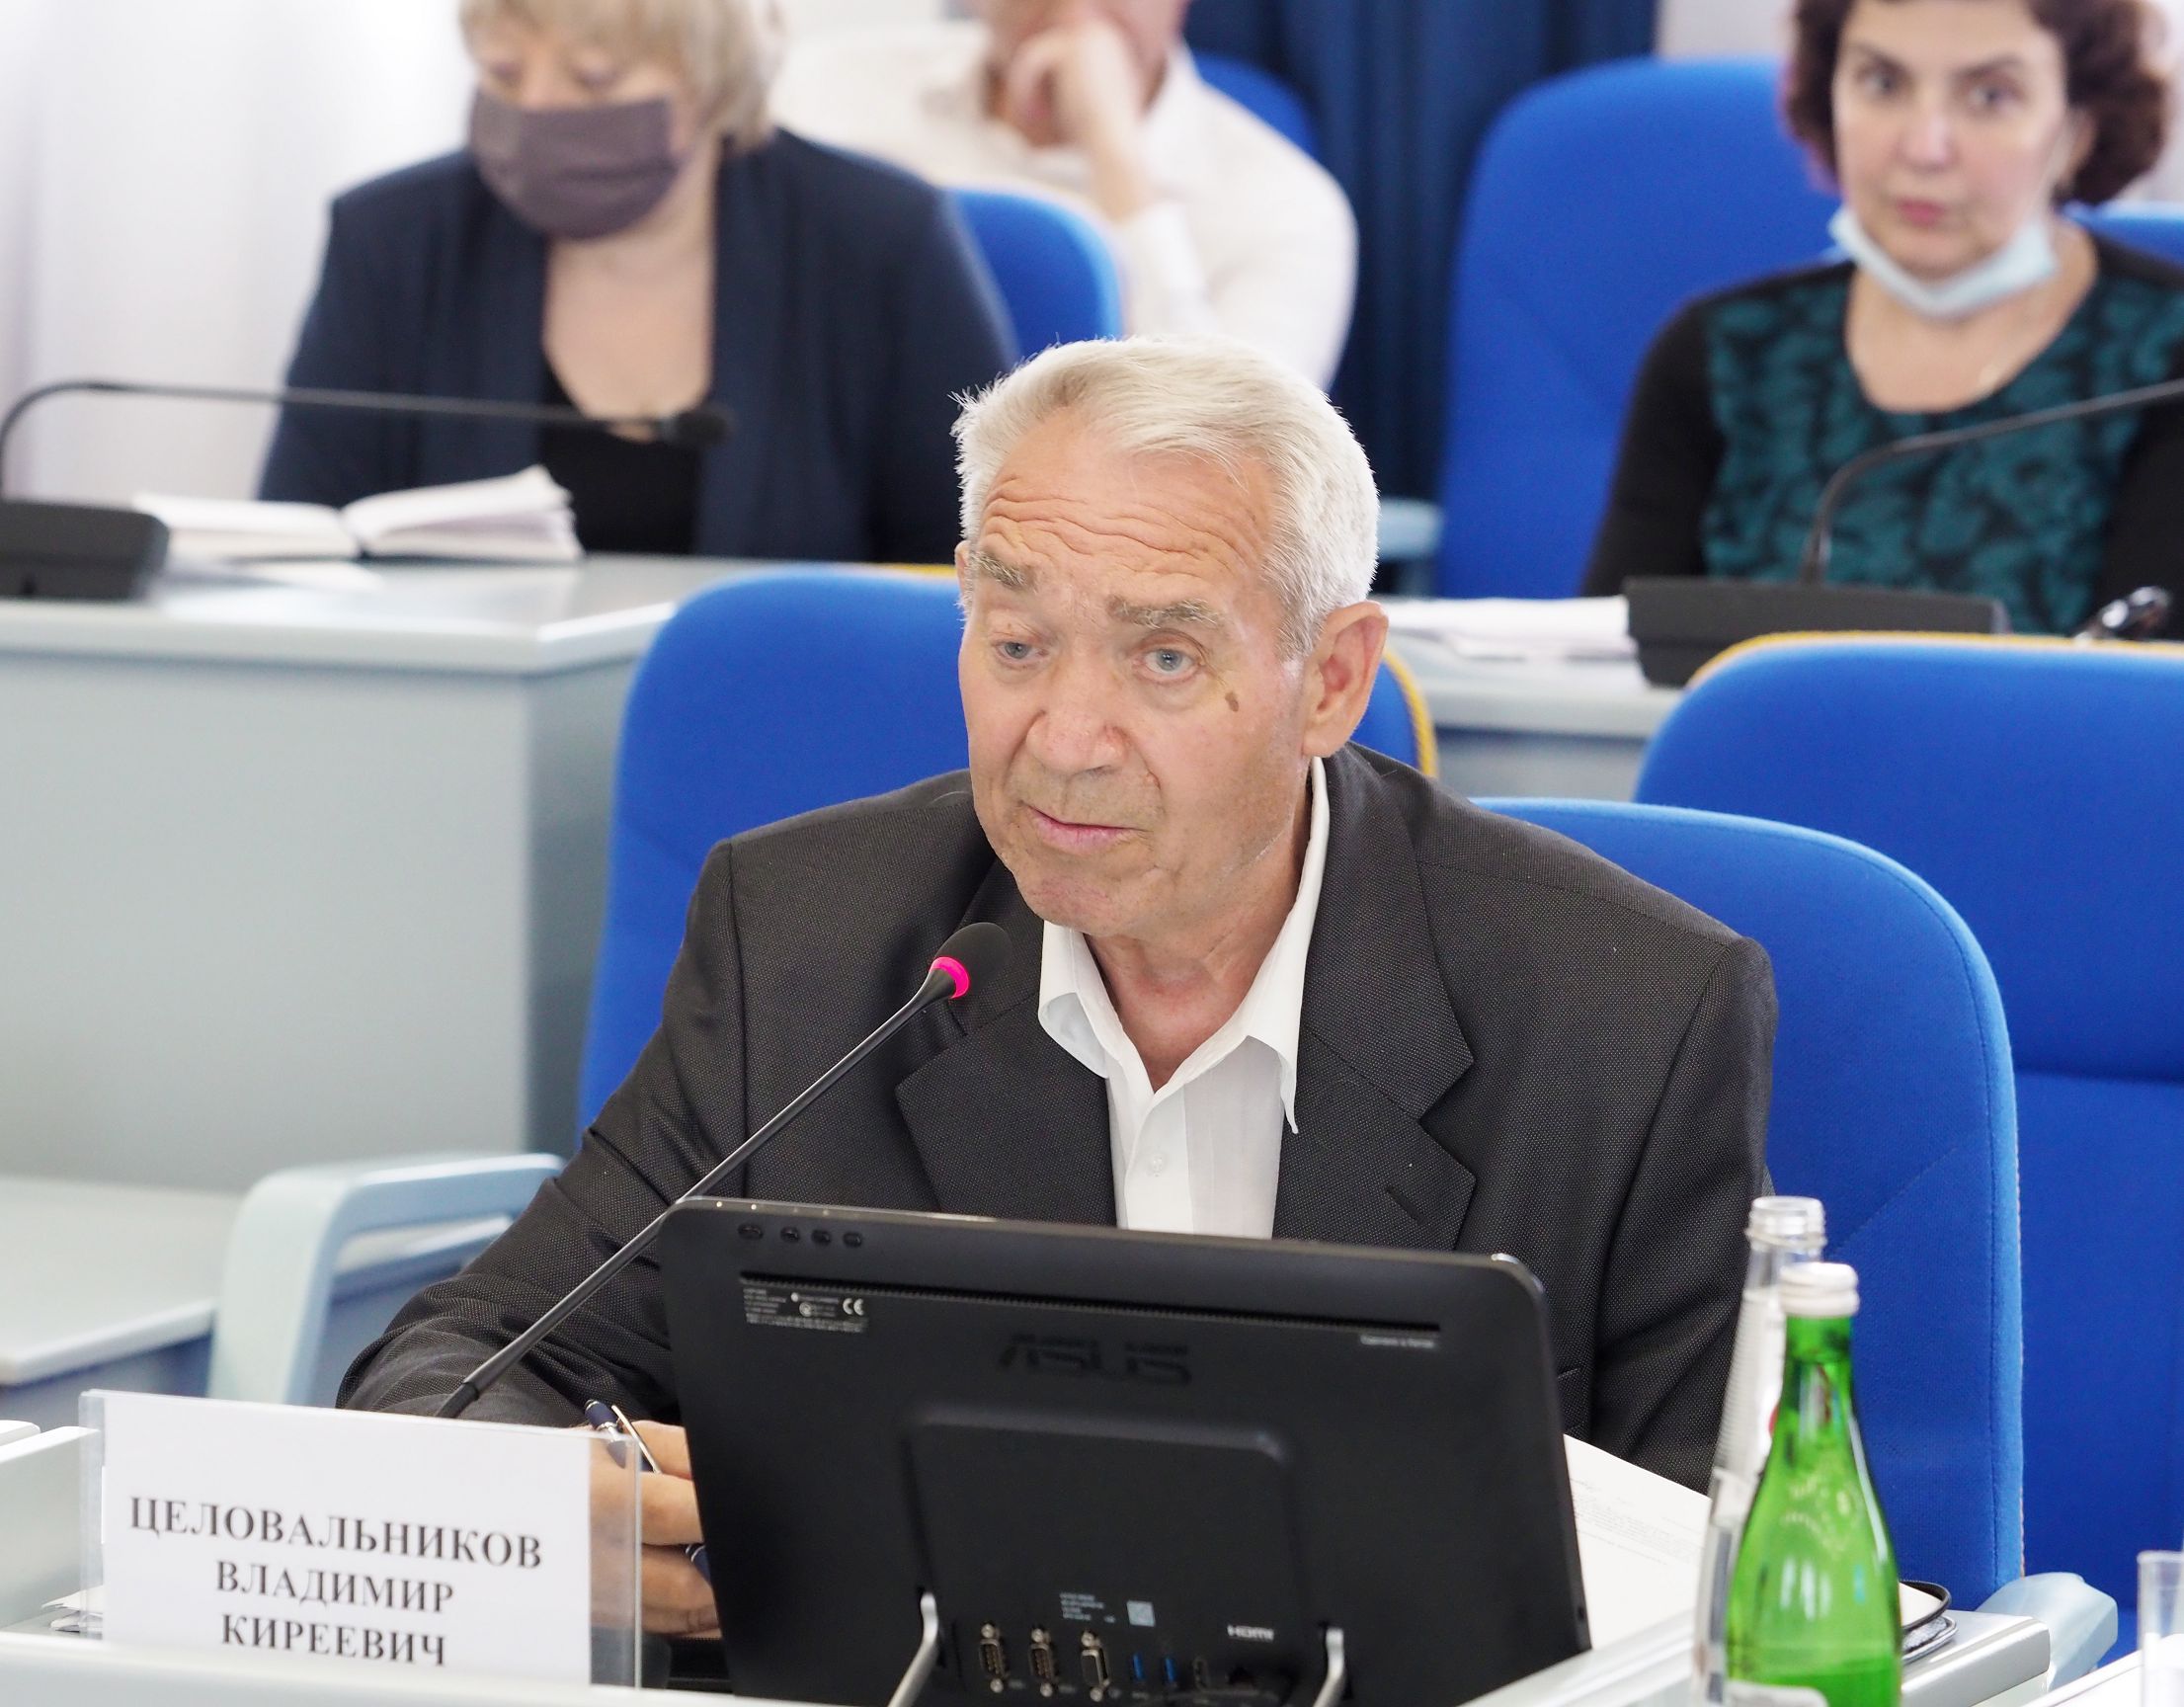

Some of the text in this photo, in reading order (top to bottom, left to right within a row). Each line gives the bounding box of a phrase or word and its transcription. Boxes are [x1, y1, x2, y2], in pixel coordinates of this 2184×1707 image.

[998, 1334, 1192, 1385] ASUS
[130, 1496, 542, 1570] ЦЕЛОВАЛЬНИКОВ
[216, 1560, 454, 1614] ВЛАДИМИР
[221, 1613, 446, 1667] КИРЕЕВИЧ
